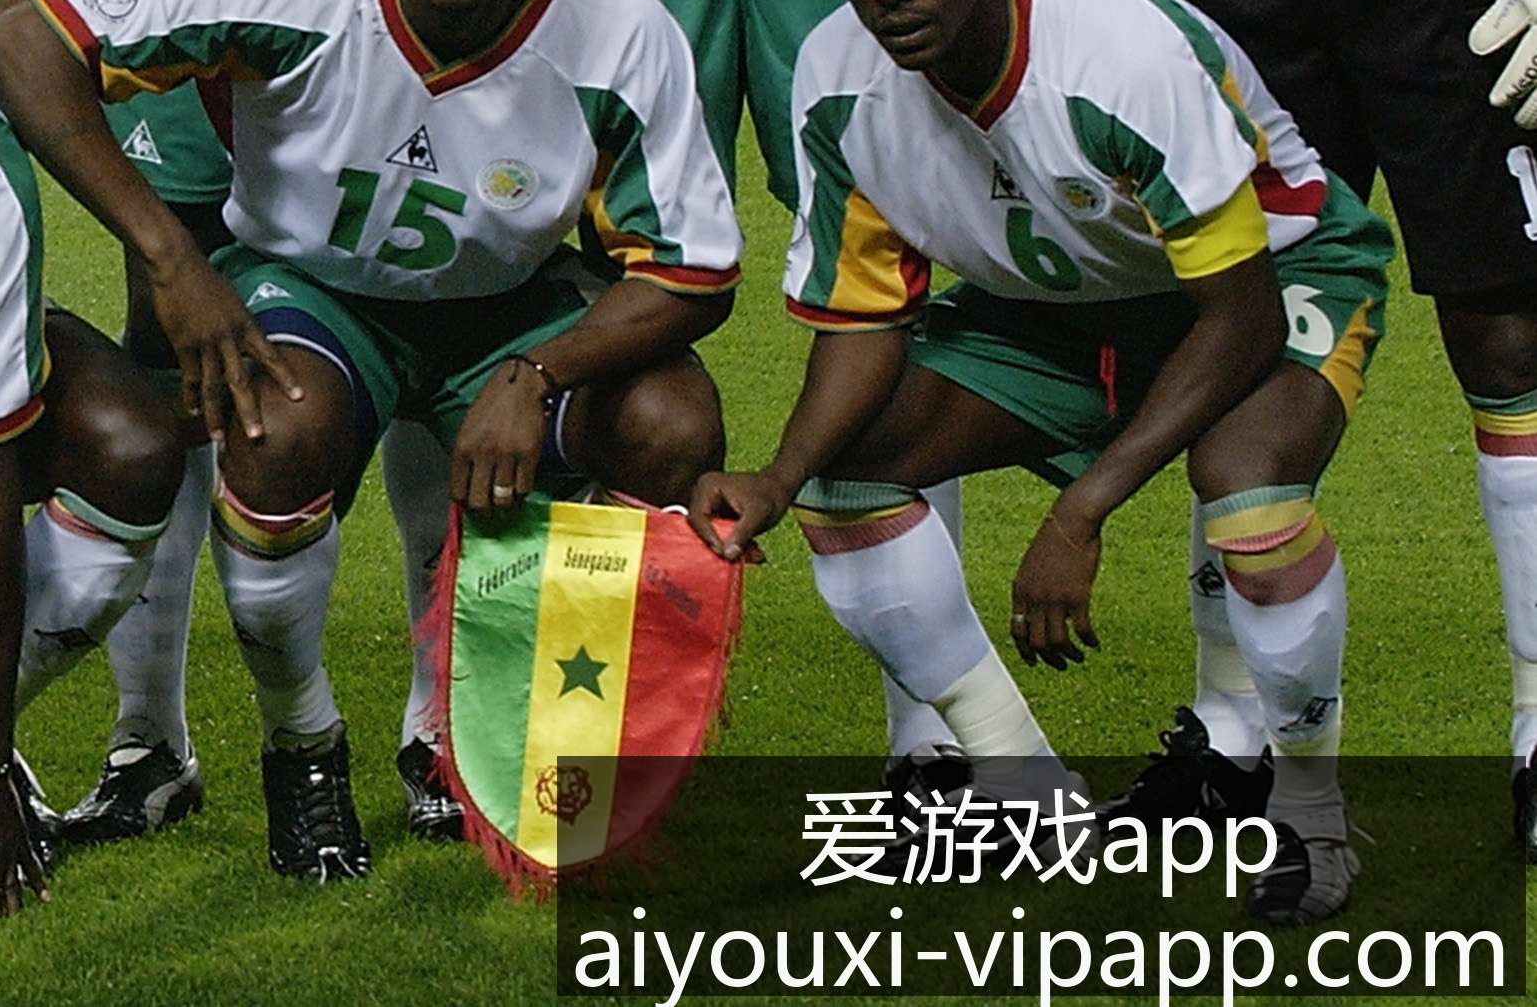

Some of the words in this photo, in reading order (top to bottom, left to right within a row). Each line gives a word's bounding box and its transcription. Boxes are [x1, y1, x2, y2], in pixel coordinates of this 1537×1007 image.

[330, 168, 468, 271] 15
[1004, 205, 1083, 292] 6
[1282, 284, 1335, 356] 6
